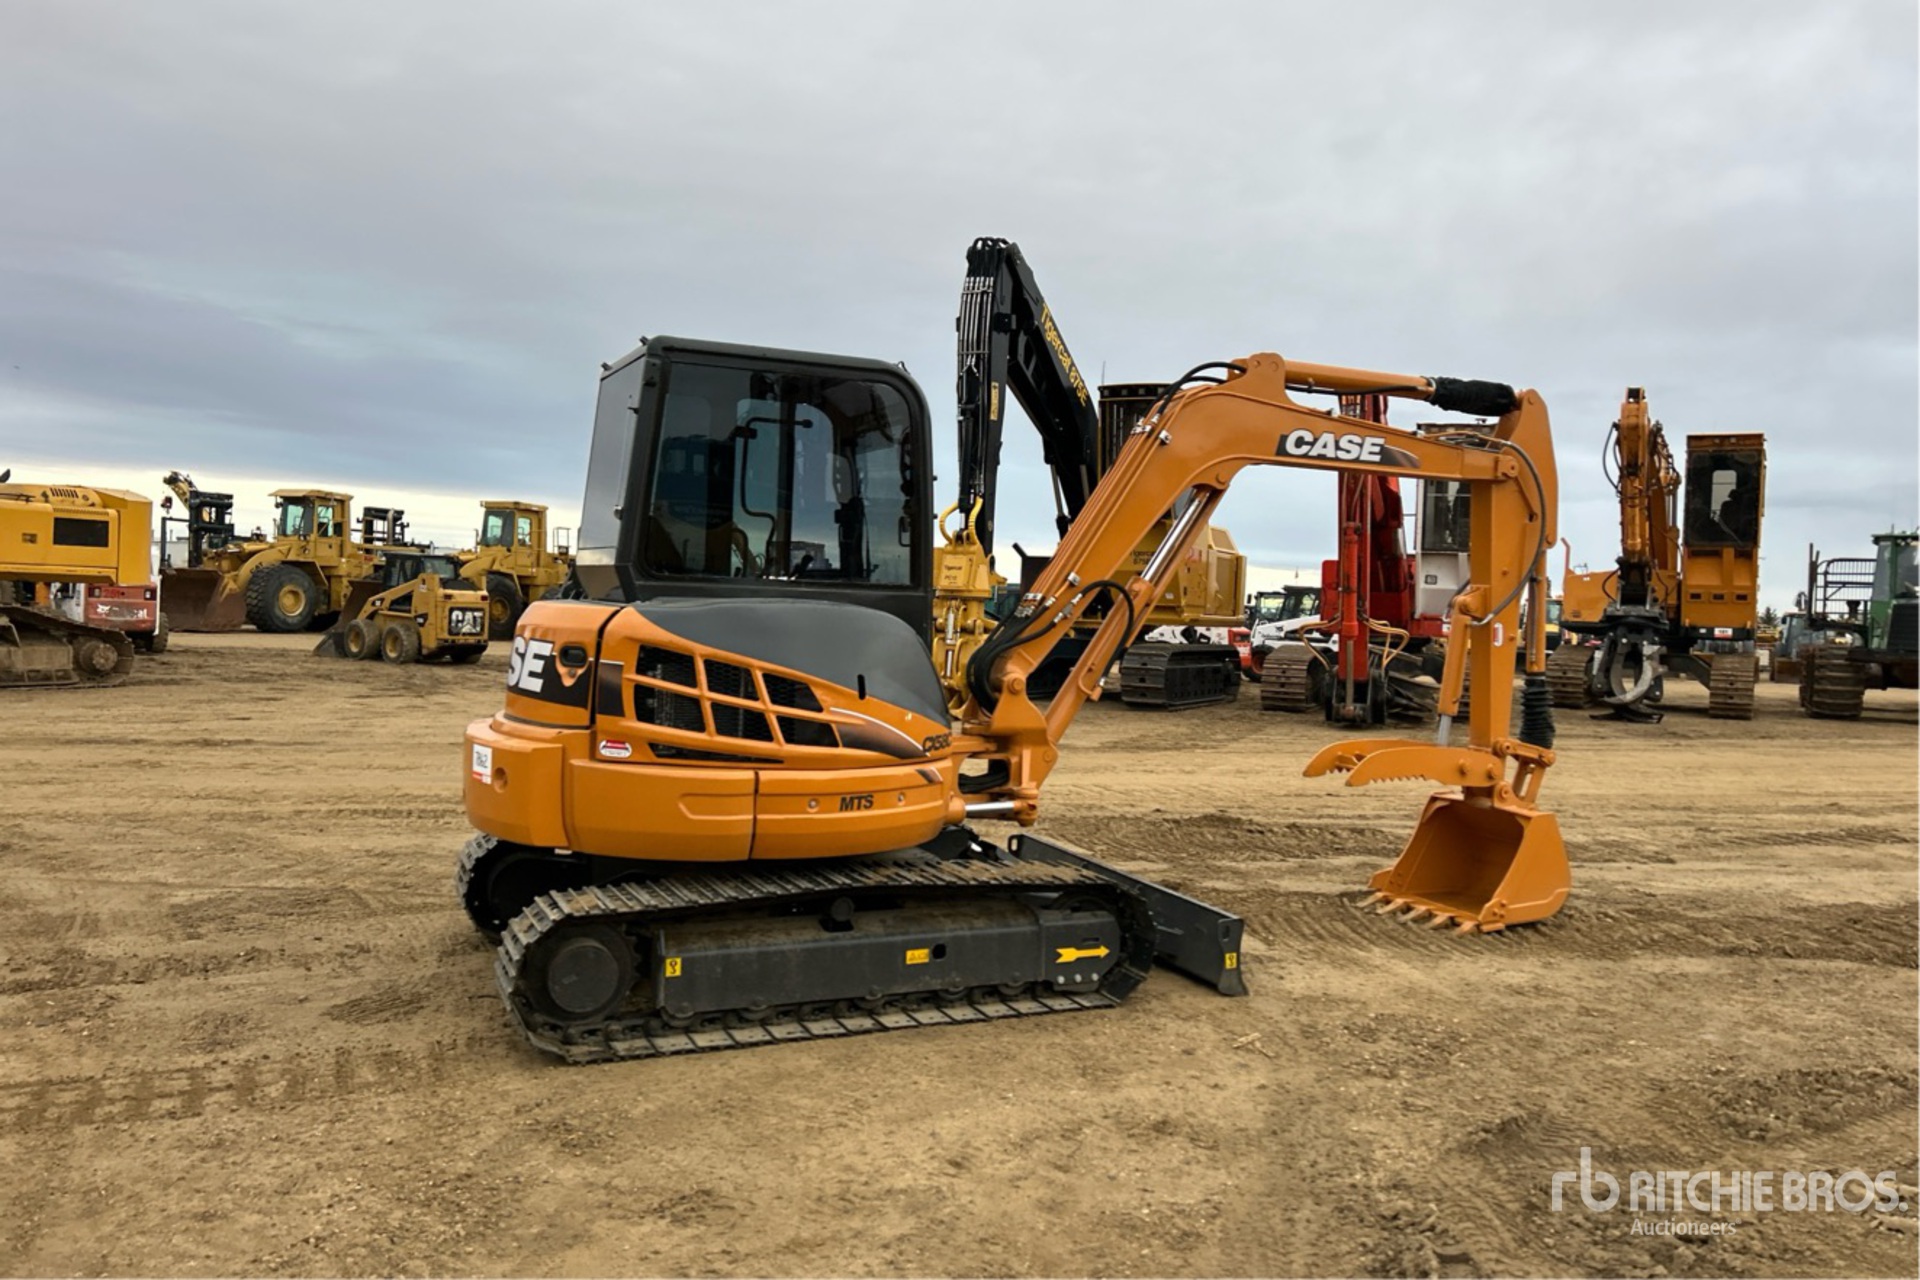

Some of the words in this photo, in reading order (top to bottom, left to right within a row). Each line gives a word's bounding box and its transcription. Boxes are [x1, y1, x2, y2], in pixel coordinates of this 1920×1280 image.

[1041, 303, 1071, 374] Tigercat
[1285, 429, 1385, 462] CASE
[450, 610, 484, 634] CAT
[507, 636, 554, 693] SE
[839, 794, 874, 812] MTS
